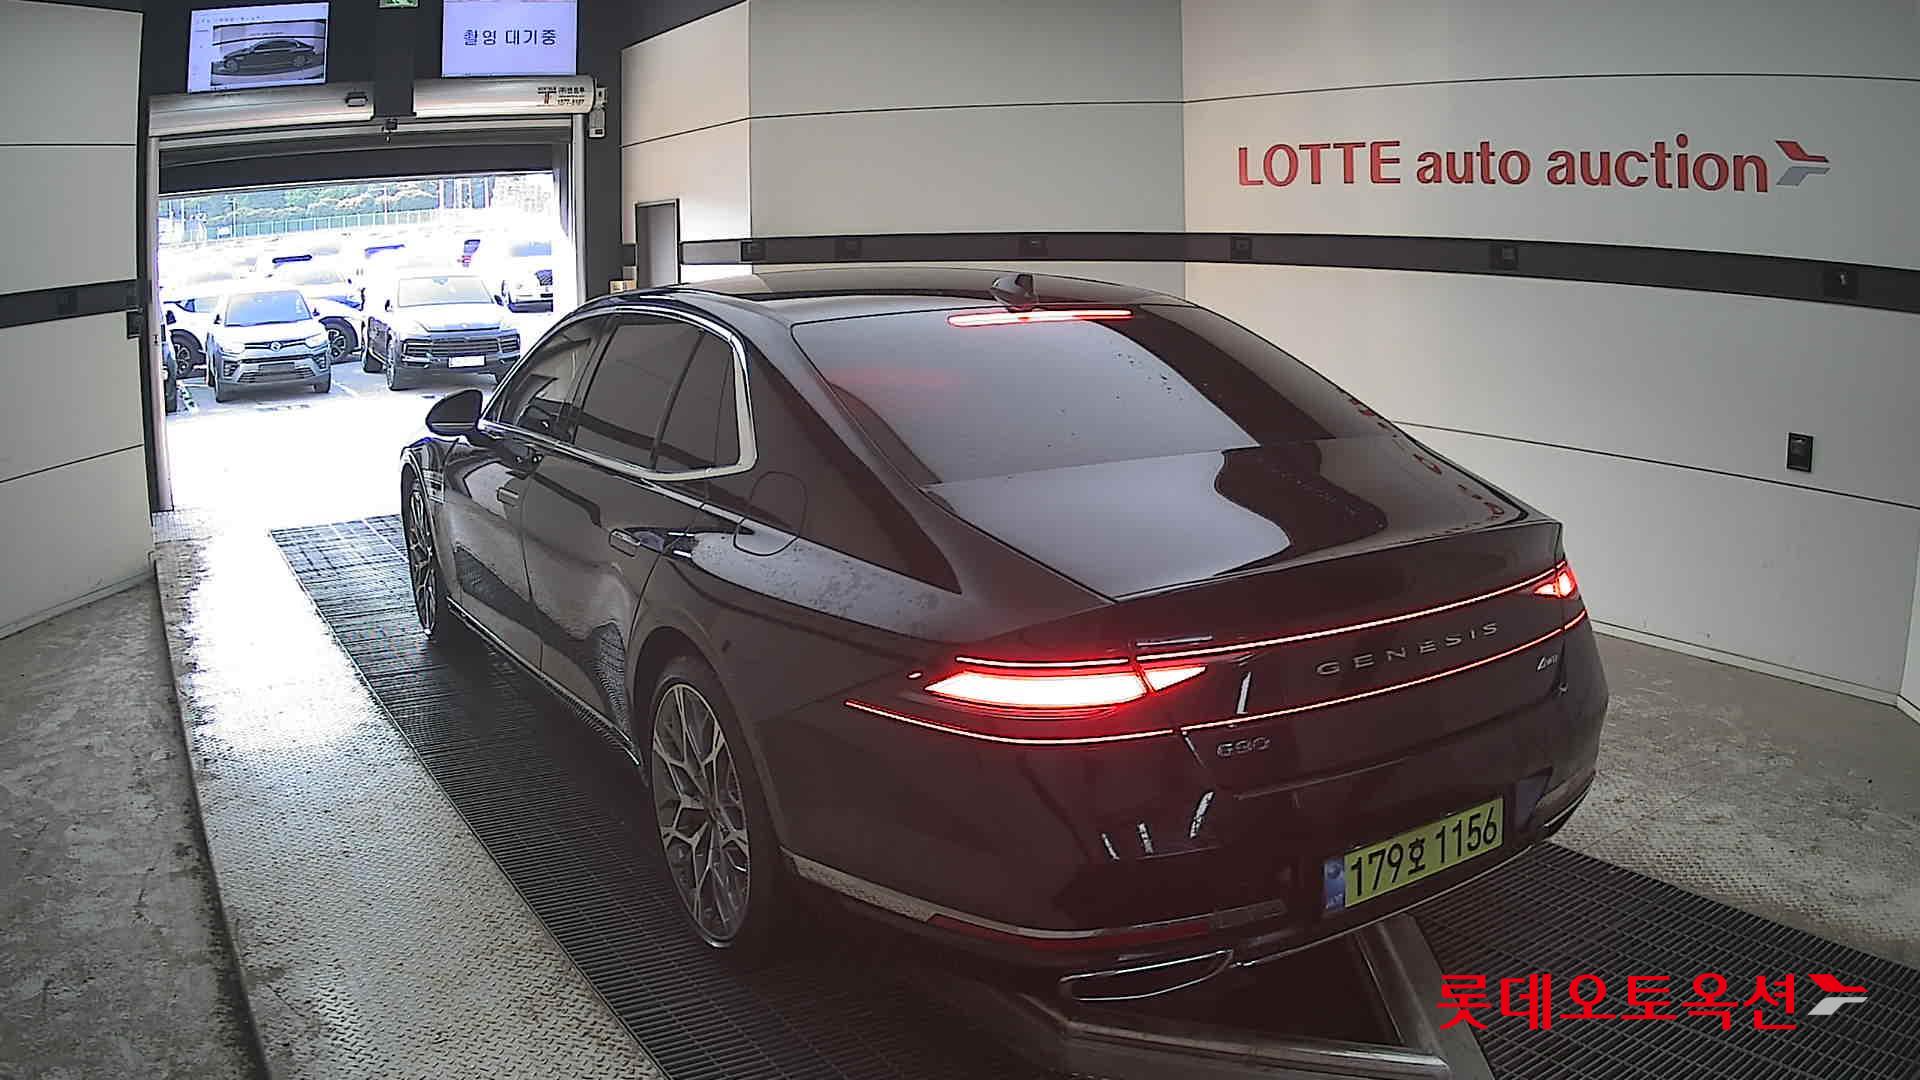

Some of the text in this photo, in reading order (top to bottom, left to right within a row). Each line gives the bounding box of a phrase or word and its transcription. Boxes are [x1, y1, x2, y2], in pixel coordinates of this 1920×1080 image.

[505, 29, 556, 46] 대기중
[1238, 133, 1769, 193] LOTTE auto auction
[1315, 621, 1499, 676] GENESIS
[1351, 806, 1498, 896] 179호 1156
